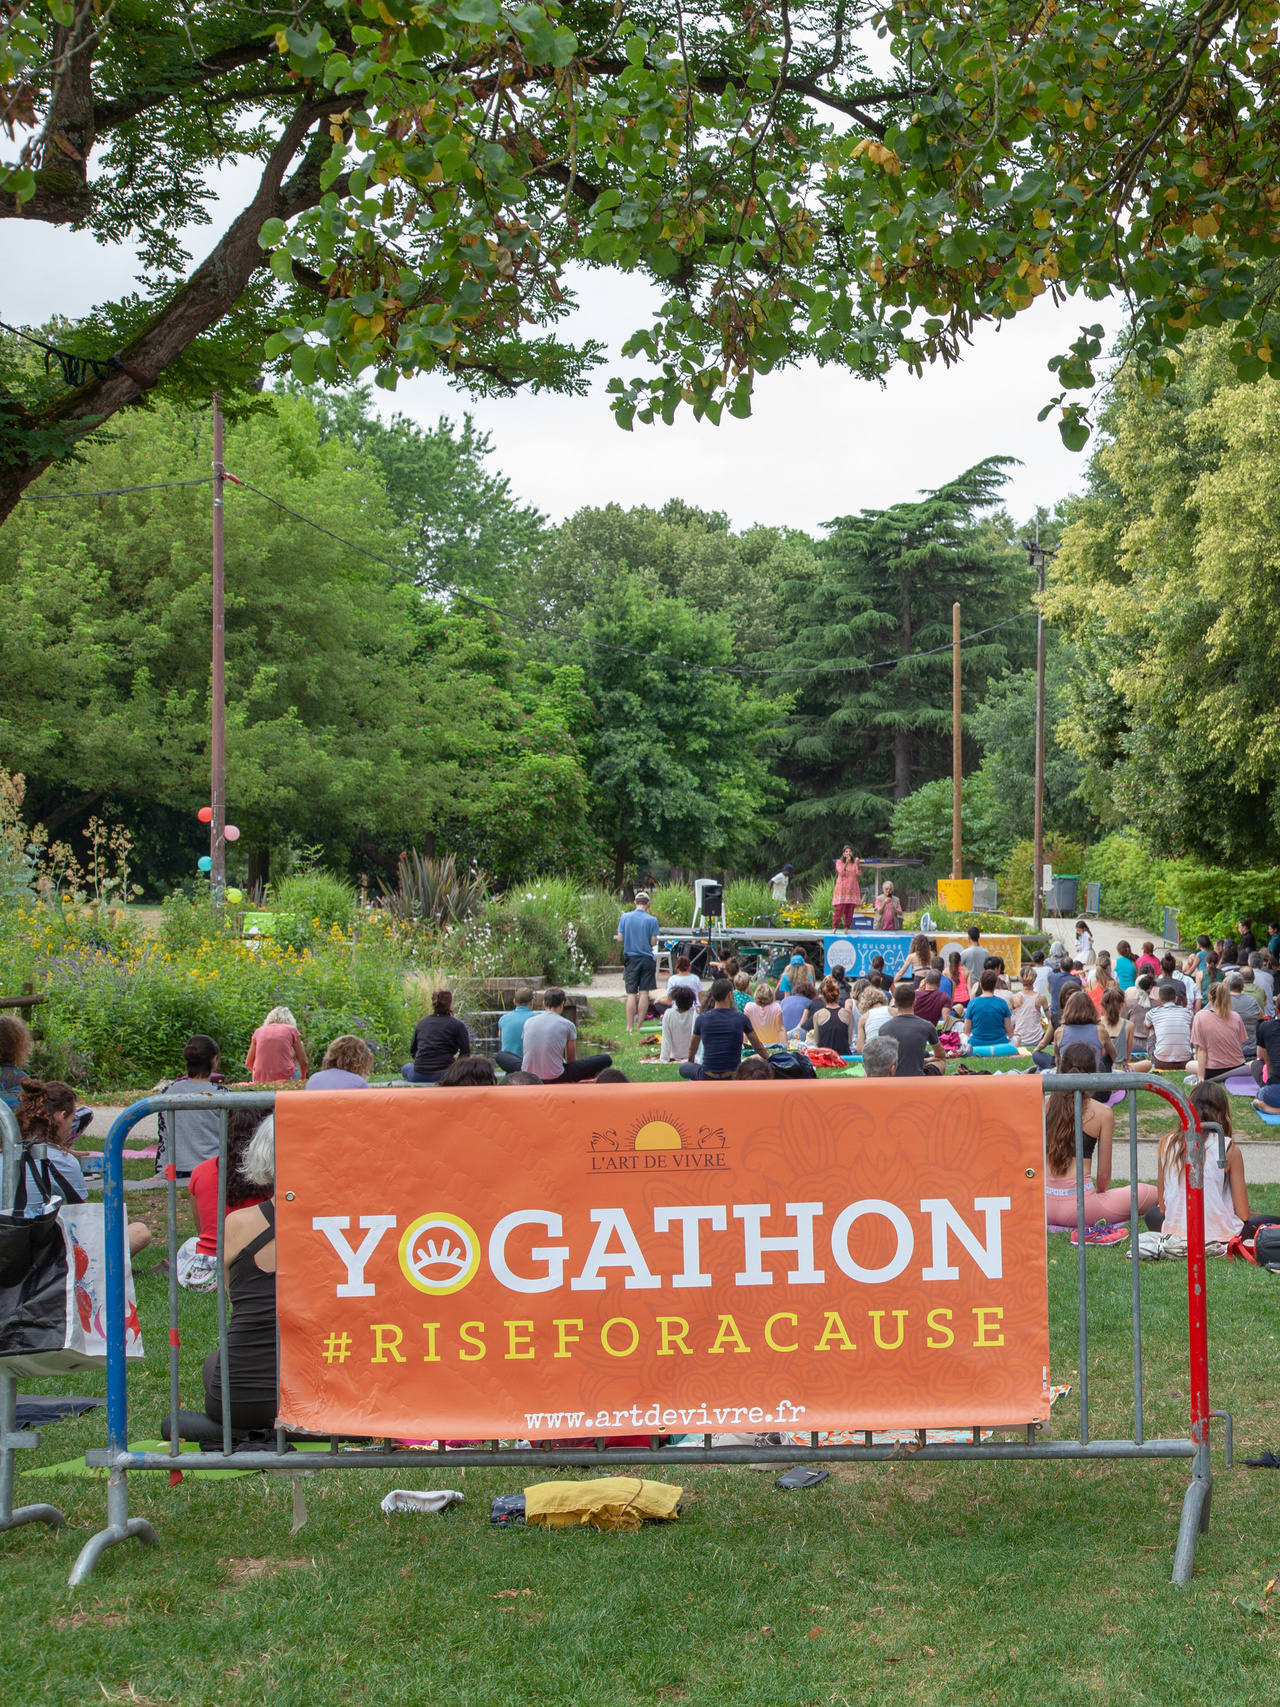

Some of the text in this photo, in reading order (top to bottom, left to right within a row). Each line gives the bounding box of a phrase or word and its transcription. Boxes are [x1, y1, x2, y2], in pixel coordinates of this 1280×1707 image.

[829, 957, 853, 966] YOGA
[857, 949, 906, 966] YOGA
[592, 1153, 726, 1170] L'ART DE VIVRE
[313, 1197, 1011, 1297] YOGATHON
[524, 1399, 806, 1430] www.artdevivre.fr
